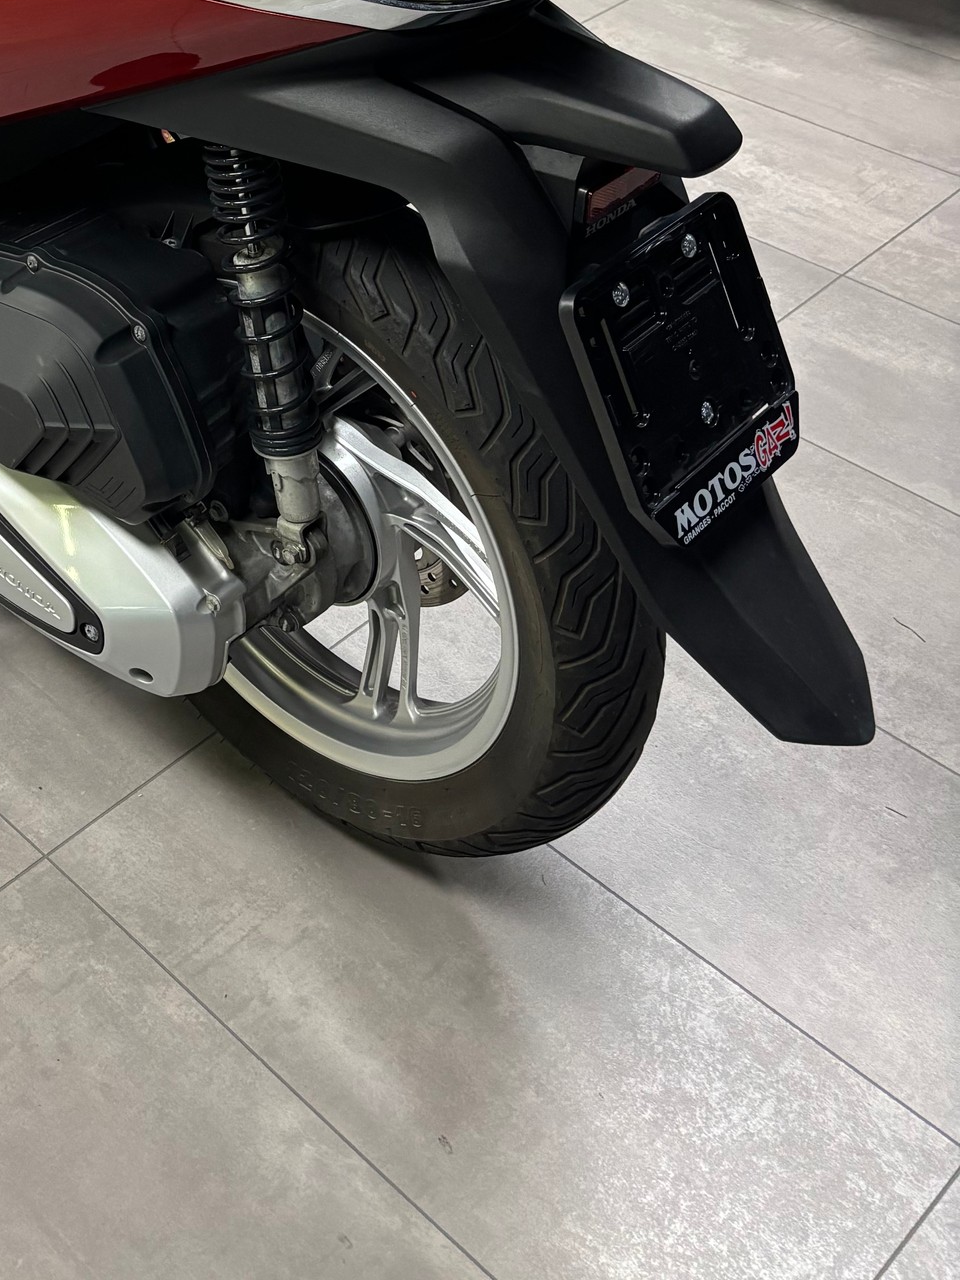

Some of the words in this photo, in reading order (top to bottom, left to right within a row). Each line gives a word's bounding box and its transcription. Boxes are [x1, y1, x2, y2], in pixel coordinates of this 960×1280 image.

[585, 199, 637, 238] HONDA
[683, 515, 711, 544] GRANGES
[713, 492, 737, 518] PACCOT
